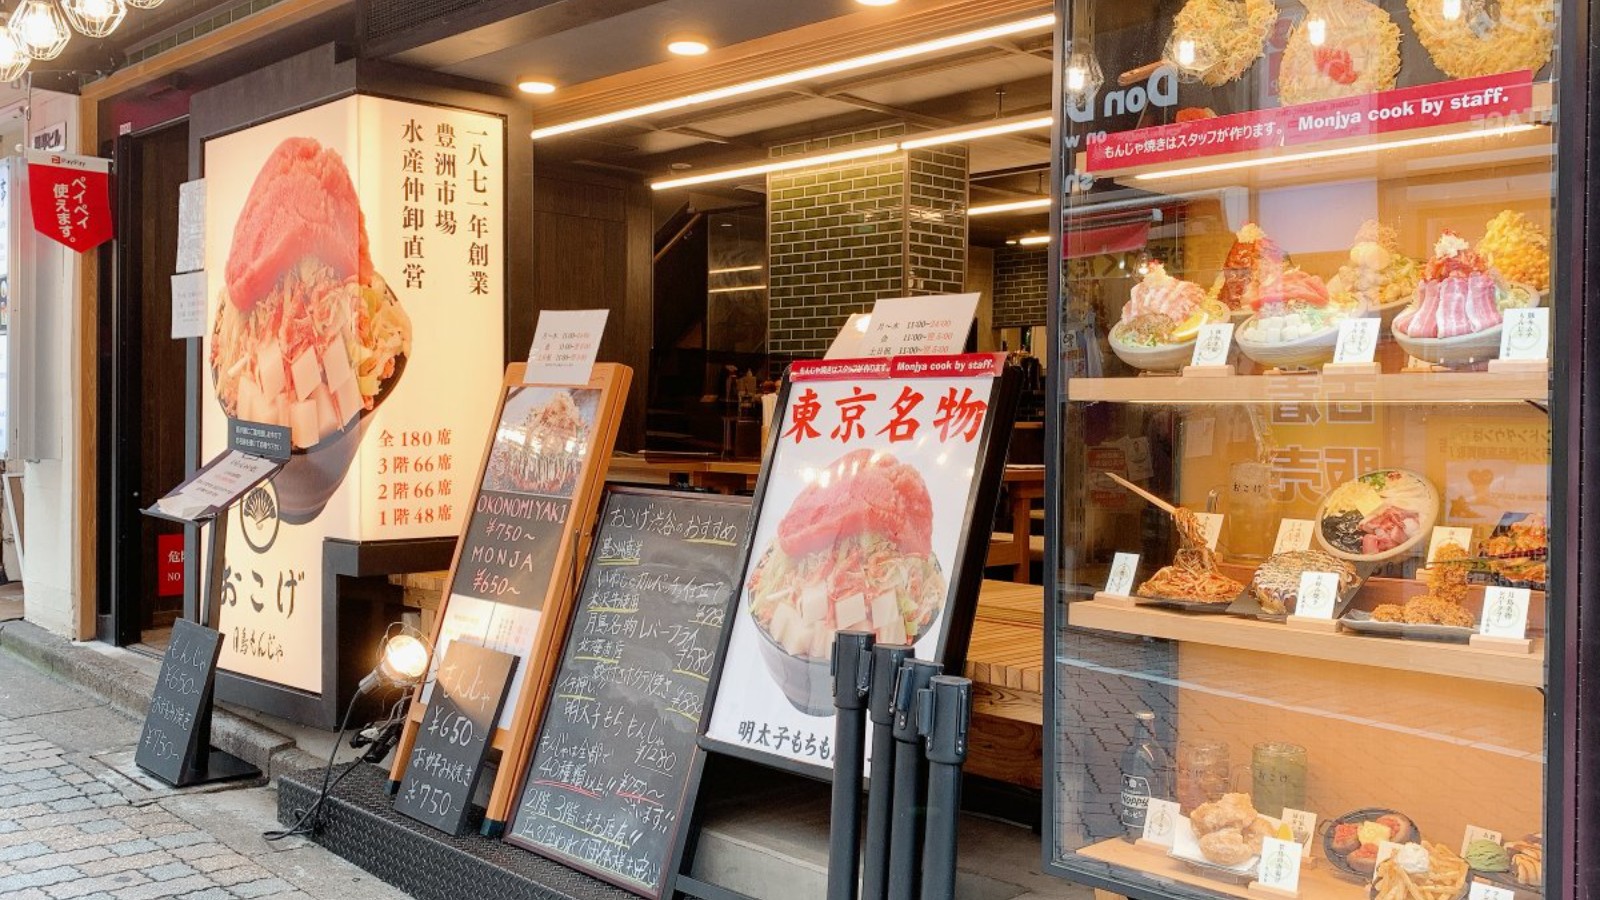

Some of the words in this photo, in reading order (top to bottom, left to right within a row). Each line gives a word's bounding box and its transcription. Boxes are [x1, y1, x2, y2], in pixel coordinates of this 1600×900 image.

[1298, 109, 1361, 131] Monjya
[1368, 101, 1415, 121] cook
[1421, 98, 1444, 116] by
[1450, 87, 1509, 109] staff.
[1104, 120, 1283, 160] もんじゃ焼きはスタッフが作ります。
[434, 122, 457, 236] 豊洲市場
[53, 183, 76, 243] 使えます。
[71, 176, 90, 229] ペイペイ
[401, 118, 426, 290] 水産仲卸直営
[466, 130, 489, 295] 一八七一年創業
[896, 361, 928, 373] Monjya
[930, 361, 951, 371] cook
[954, 360, 966, 372] by
[967, 359, 995, 370] staff.
[781, 386, 988, 444] 東京名物
[476, 495, 568, 524] OKONOMIYAKI
[167, 572, 181, 582] NO
[168, 550, 185, 563] 危
[471, 545, 534, 573] MONJA
[220, 565, 305, 619] おこげ
[738, 720, 834, 761] 明太子もちも
